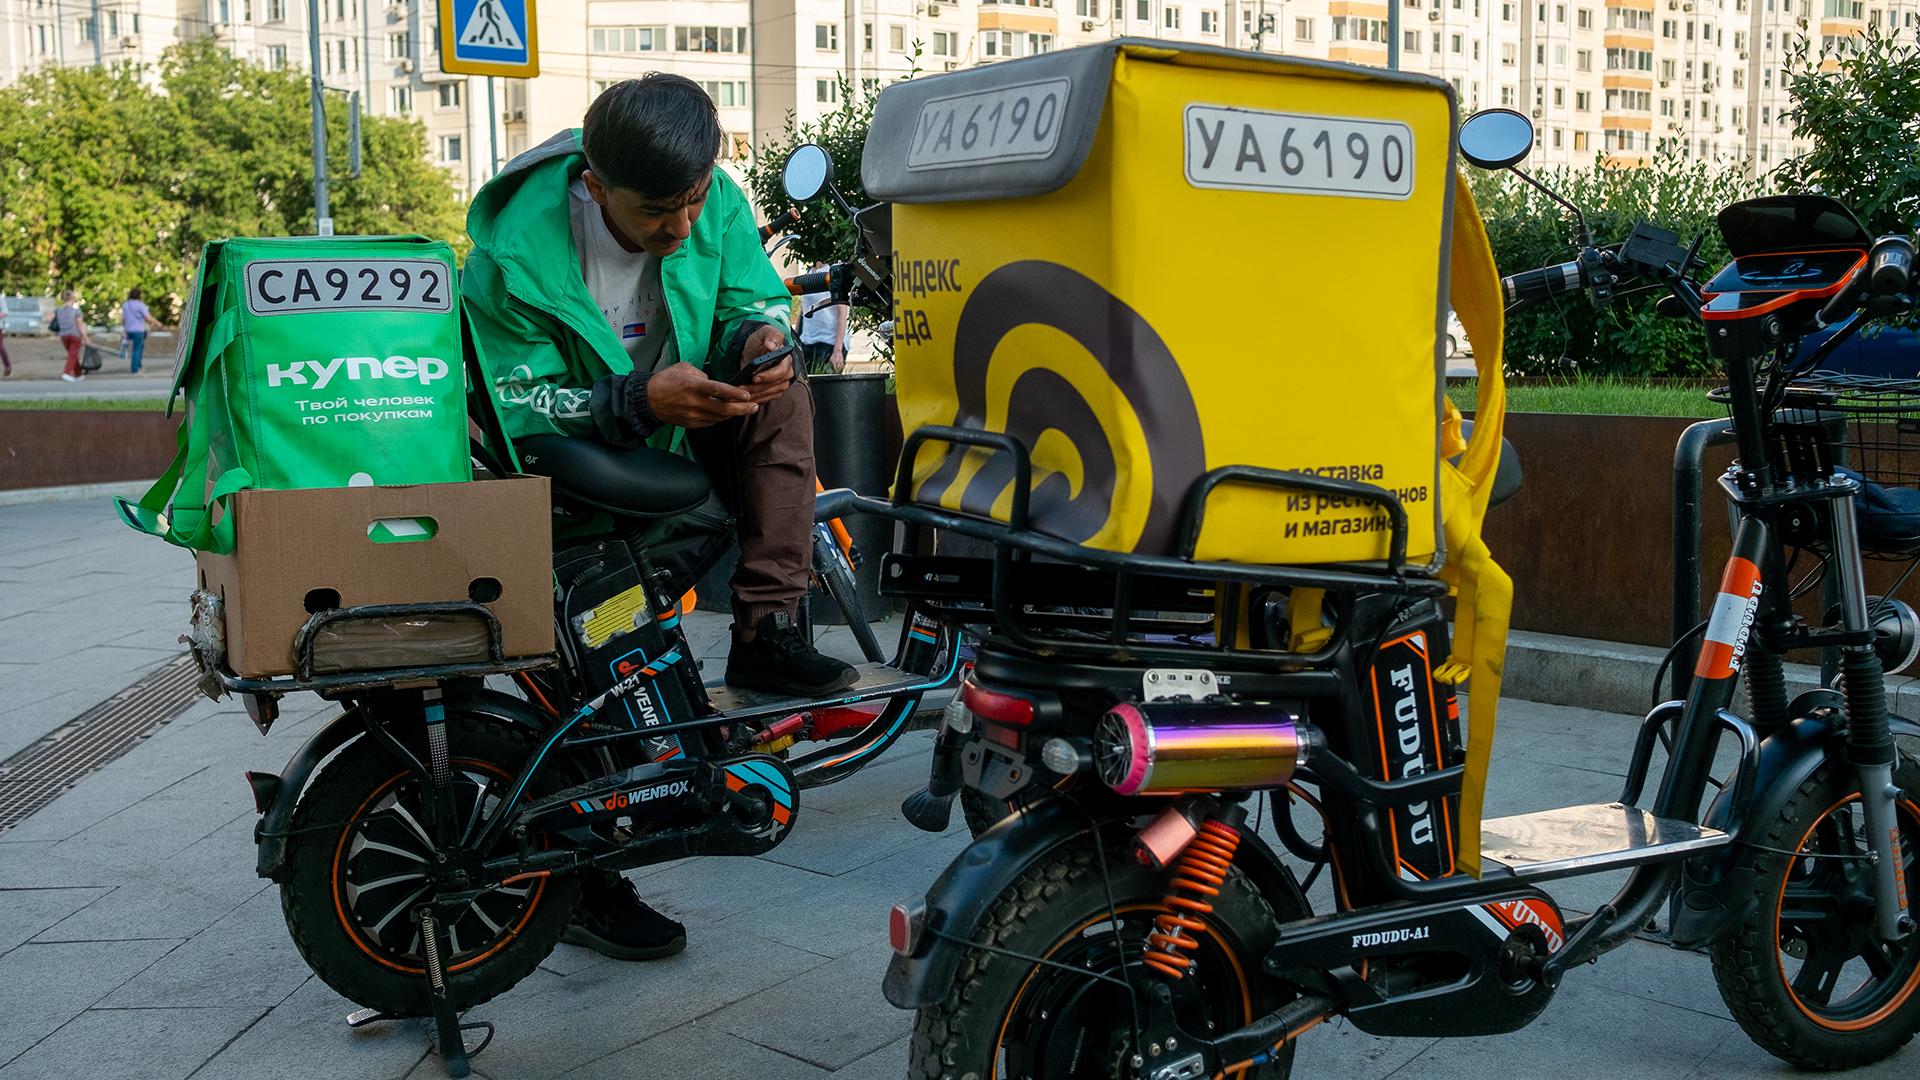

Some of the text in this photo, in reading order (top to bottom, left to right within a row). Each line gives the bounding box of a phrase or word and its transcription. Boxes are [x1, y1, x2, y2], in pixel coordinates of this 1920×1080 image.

[916, 93, 1057, 156] УА6190
[1195, 117, 1404, 183] УА6190
[258, 268, 441, 304] СА9292
[894, 299, 933, 346] Еда
[266, 356, 449, 390] купер
[295, 396, 435, 412] Твой человек
[302, 409, 433, 426] по покупкам
[1287, 494, 1311, 513] из
[1284, 515, 1394, 539] и магазин
[1728, 579, 1763, 672] FUDUDU
[609, 674, 641, 698] W-21
[1351, 926, 1430, 949] FUDUDU-A1
